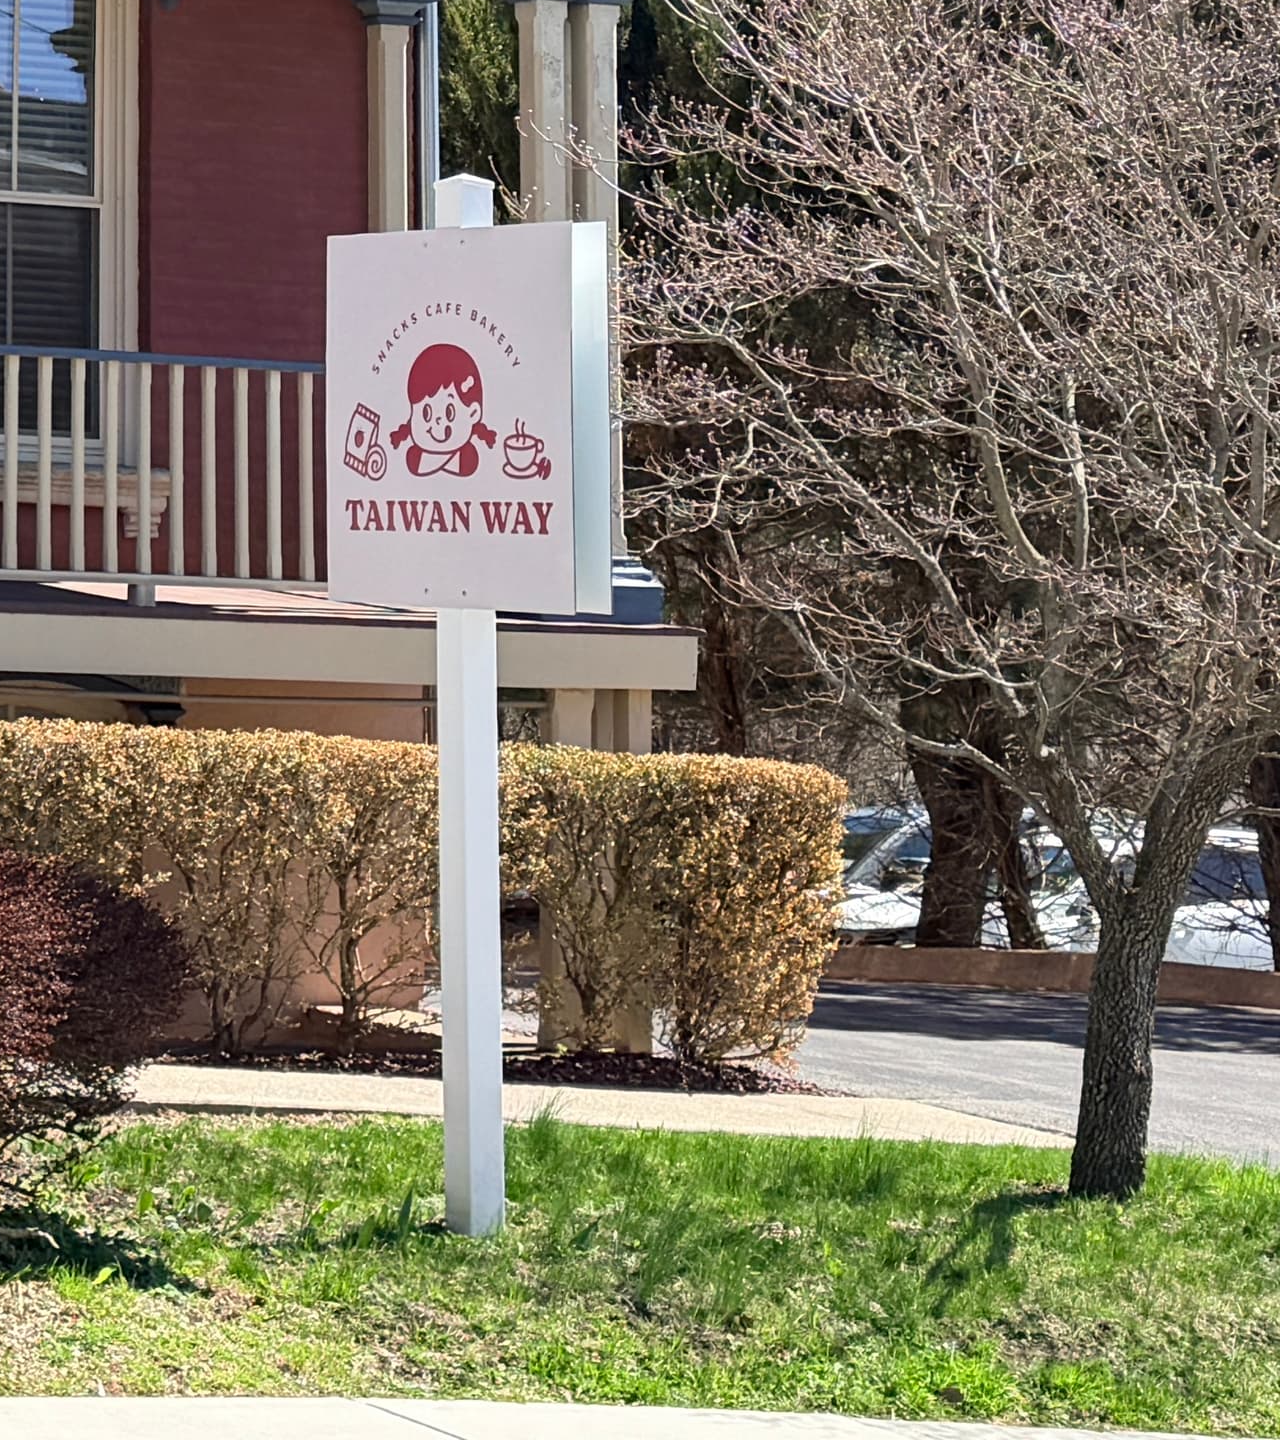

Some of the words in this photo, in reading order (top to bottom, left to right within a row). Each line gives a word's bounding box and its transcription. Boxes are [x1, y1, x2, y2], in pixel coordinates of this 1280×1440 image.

[372, 313, 418, 375] SNACKS
[425, 302, 462, 318] CAFE
[470, 309, 521, 369] BAKERY
[345, 498, 472, 534] TAIWAN
[479, 501, 554, 535] WAY
